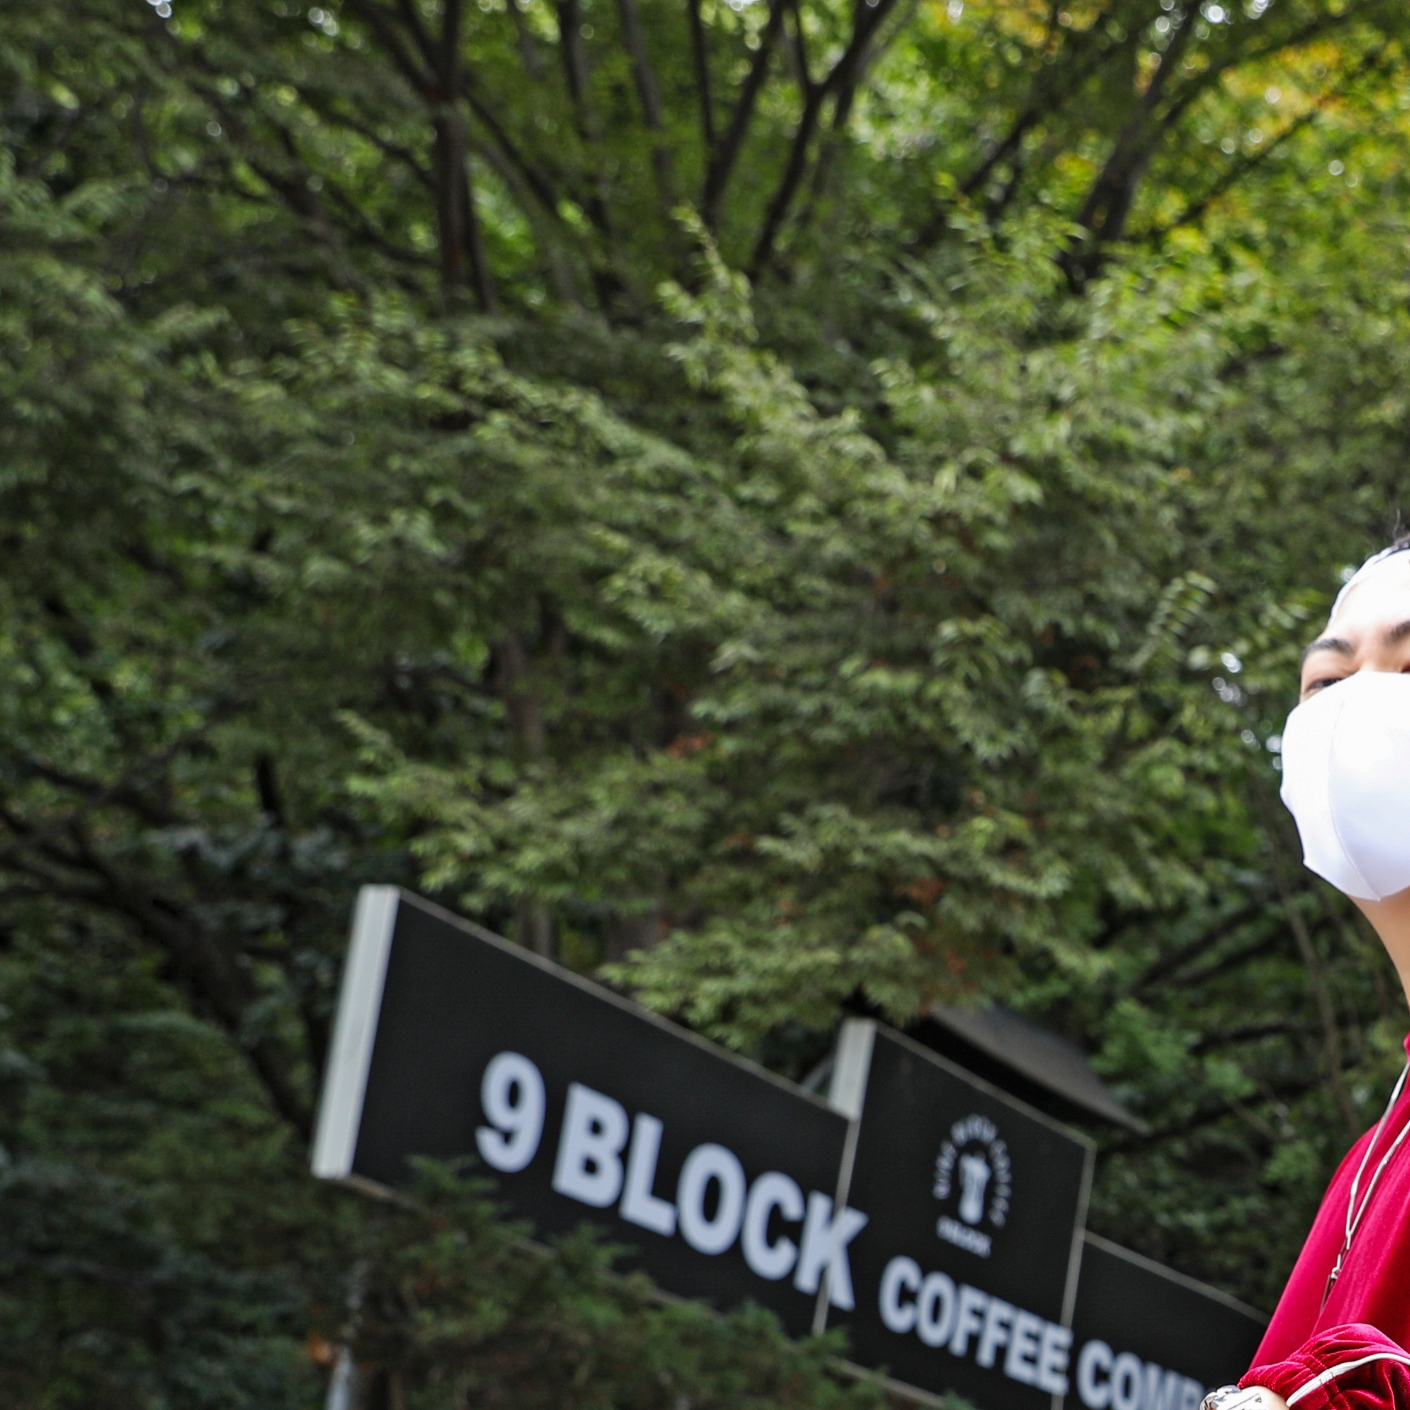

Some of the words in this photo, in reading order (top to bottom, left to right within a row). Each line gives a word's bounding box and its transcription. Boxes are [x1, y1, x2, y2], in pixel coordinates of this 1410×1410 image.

[476, 1051, 546, 1172] 9
[551, 1081, 868, 1311] BLOCK
[879, 1254, 1073, 1397] COFFEE
